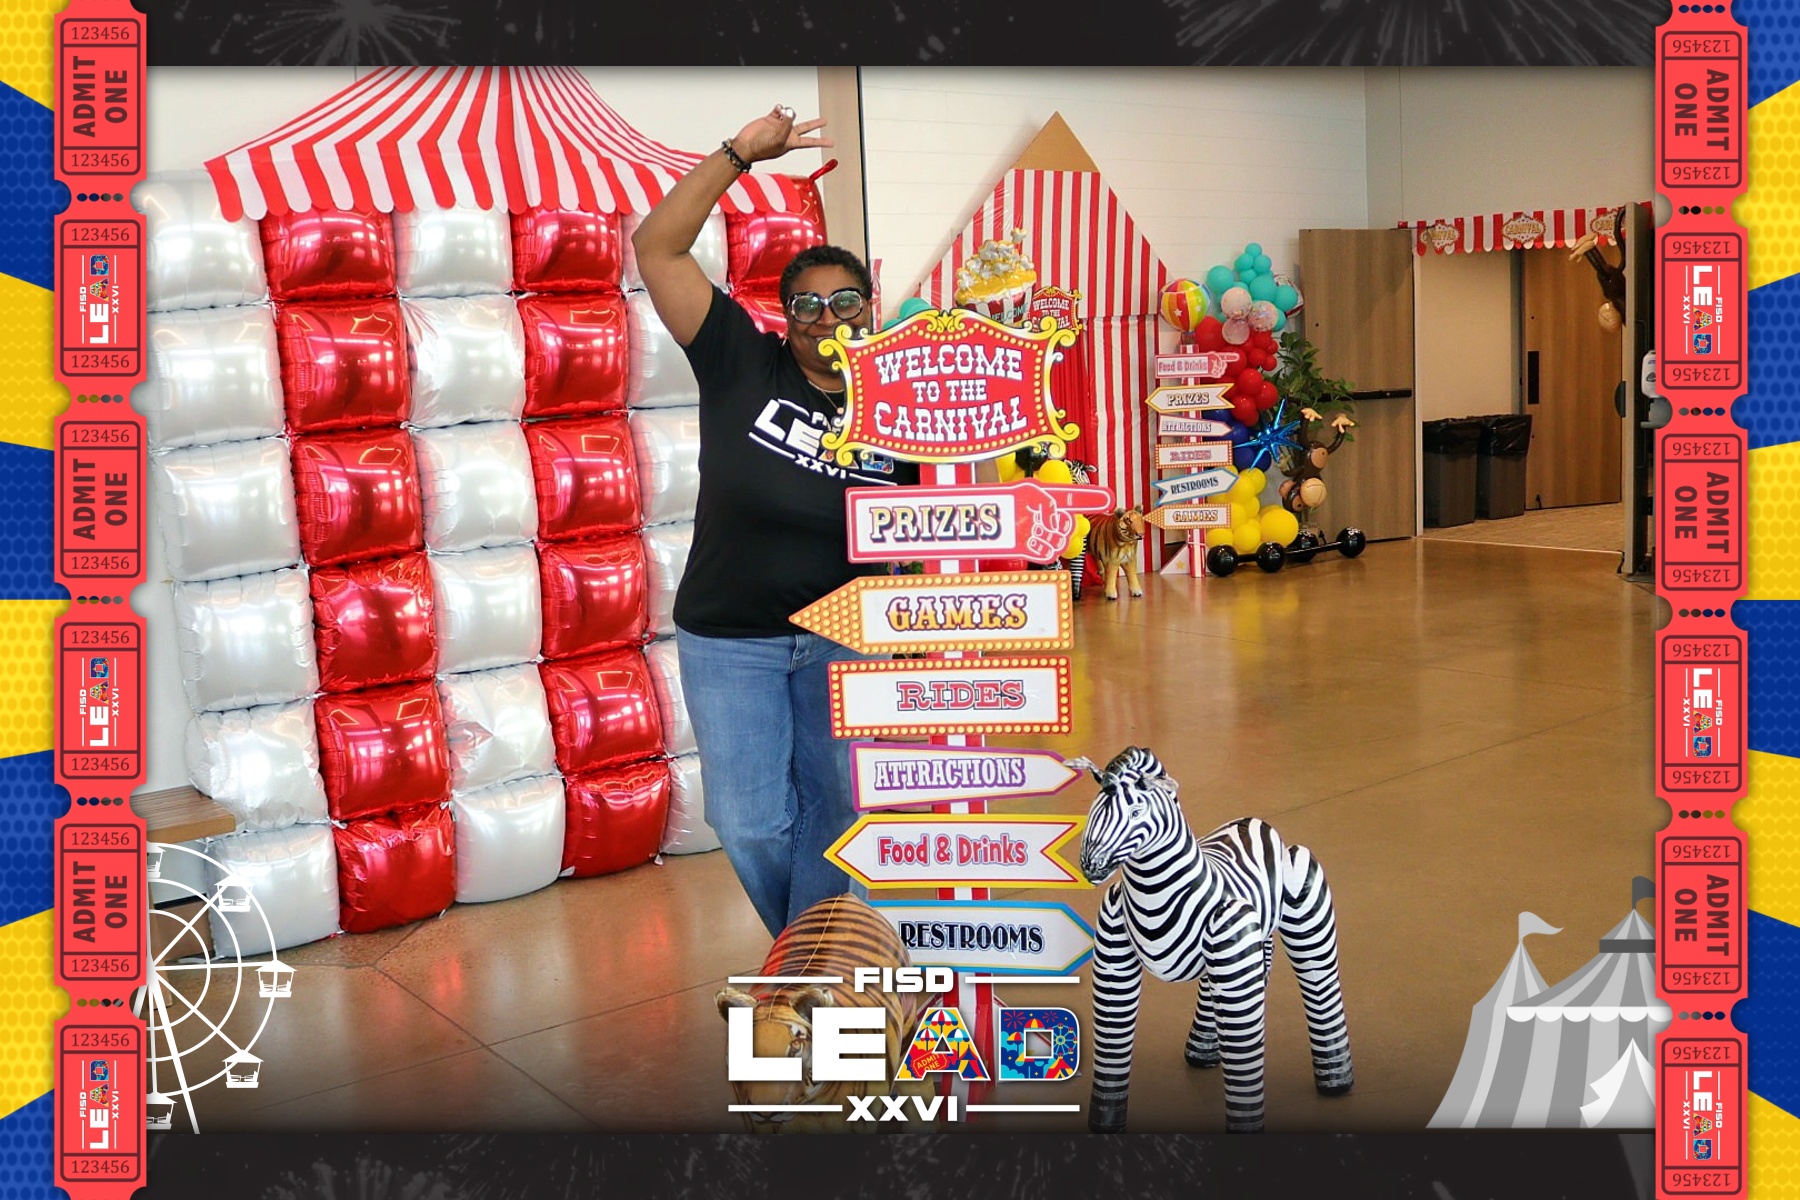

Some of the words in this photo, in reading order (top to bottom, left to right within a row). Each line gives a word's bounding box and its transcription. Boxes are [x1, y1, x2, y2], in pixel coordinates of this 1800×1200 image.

[1033, 298, 1069, 311] WELCOME
[1050, 309, 1061, 317] THE
[874, 344, 1022, 385] WELCOME
[1159, 361, 1175, 373] Food
[1184, 360, 1207, 371] Drinks
[912, 381, 940, 402] TO
[946, 379, 987, 401] THE
[1167, 392, 1210, 406] PRIZES
[874, 396, 1028, 441] CARNIVAL
[795, 453, 847, 479] XXVI
[1170, 477, 1219, 495] RESTROOMS
[869, 503, 1001, 542] PRIZES
[1172, 510, 1218, 522] GAMES
[886, 594, 1028, 631] GAMES
[897, 680, 1026, 711] RIDES
[874, 758, 1026, 790] ATTRACTIONS
[878, 834, 930, 866] Food
[934, 834, 952, 864] &
[957, 833, 1028, 866] Drinks
[900, 920, 1043, 952] RESTROOMS
